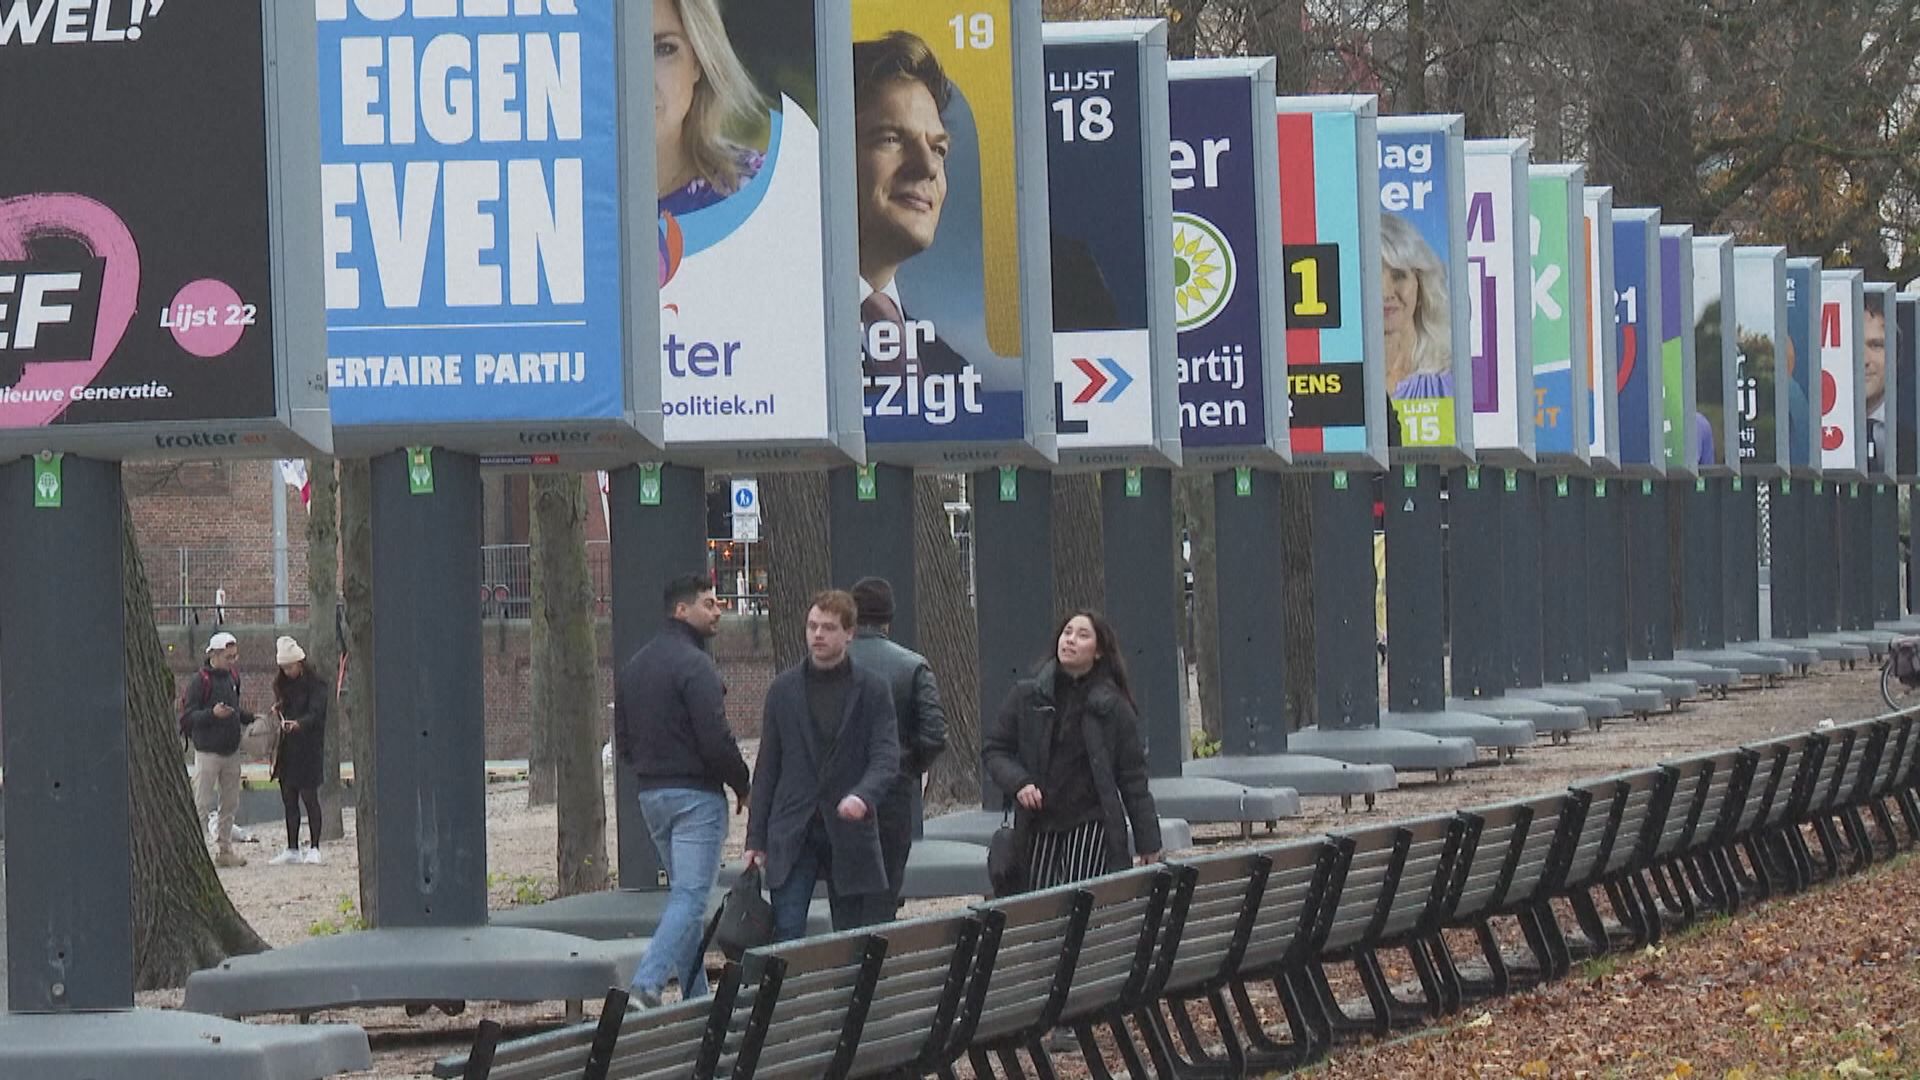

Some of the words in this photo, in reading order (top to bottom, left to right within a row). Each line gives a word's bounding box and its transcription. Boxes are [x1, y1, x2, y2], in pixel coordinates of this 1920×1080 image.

[948, 12, 995, 50] 19
[340, 32, 583, 145] EIGEN
[1048, 69, 1115, 92] LIJST
[1051, 96, 1115, 142] 18
[1380, 180, 1433, 211] er
[321, 158, 586, 310] EVEN
[159, 304, 217, 332] Lijst
[223, 303, 258, 326] 22
[326, 354, 463, 388] ERTAIRE
[474, 351, 586, 384] PARTIJ
[663, 334, 741, 377] ter
[69, 381, 174, 401] Generatie.
[662, 394, 775, 417] politiek.nl
[1403, 401, 1439, 415] LIJST
[155, 431, 238, 449] trotter
[519, 430, 591, 445] trotter
[1404, 415, 1441, 443] 15
